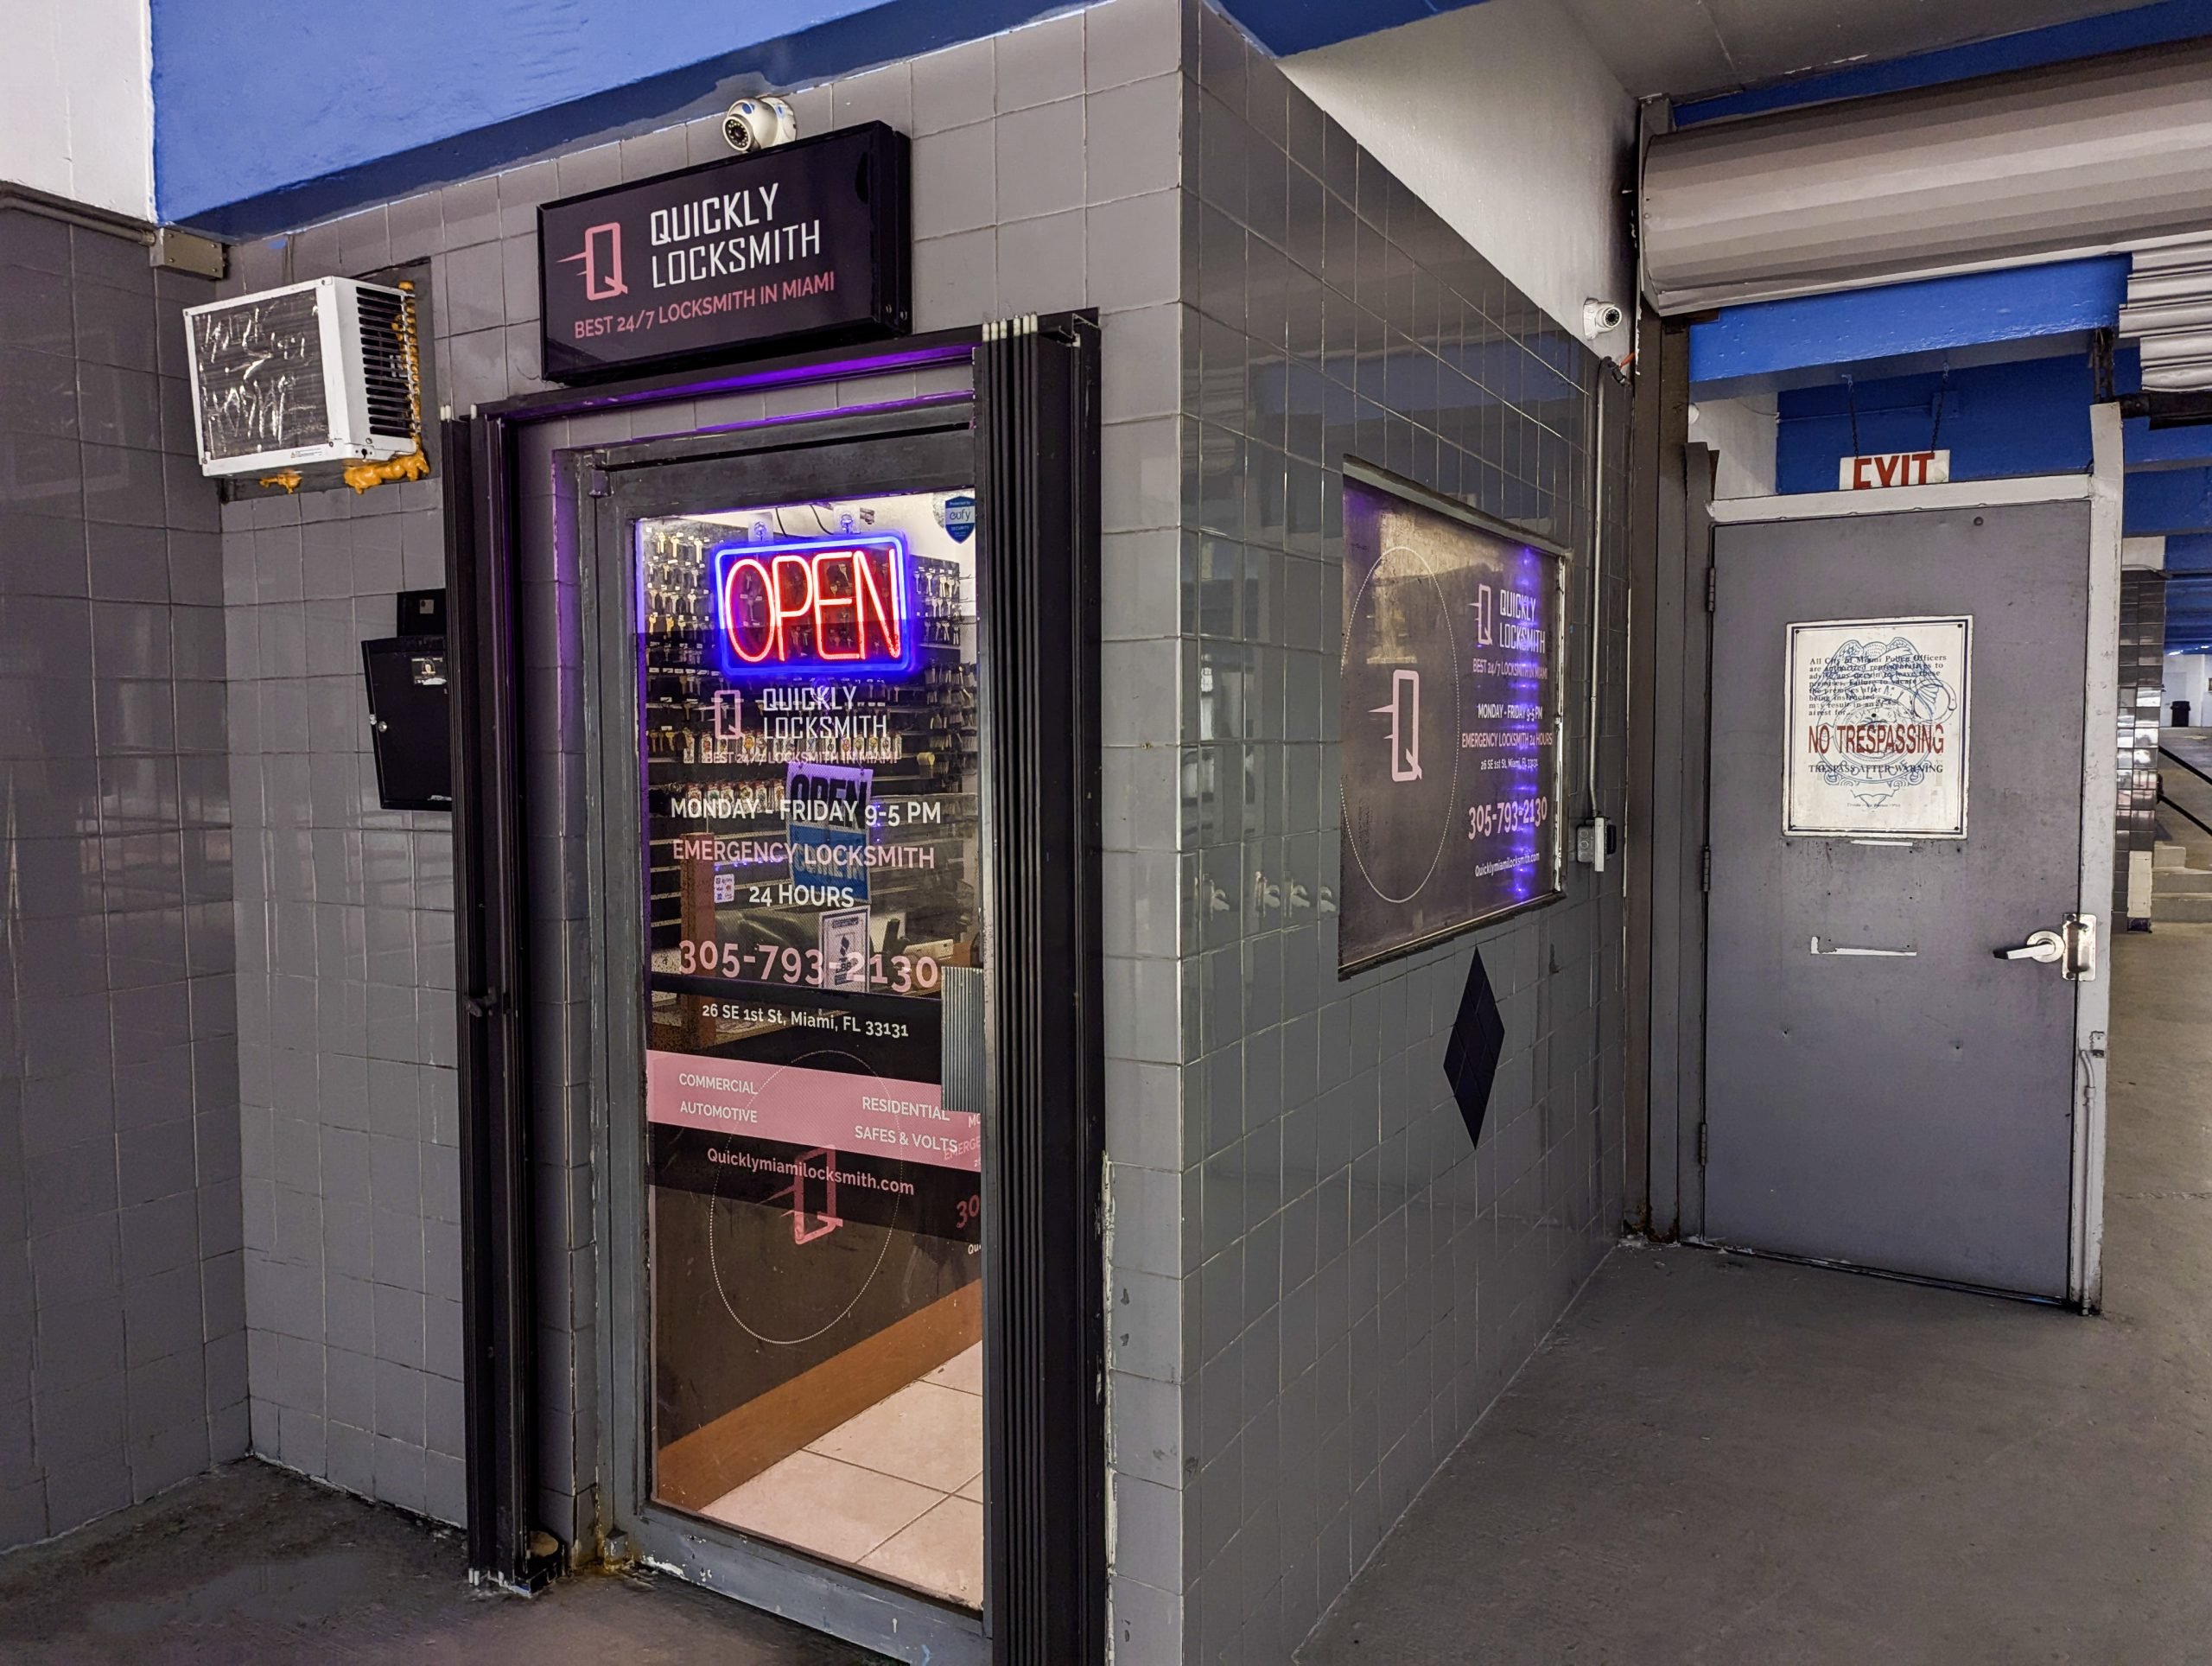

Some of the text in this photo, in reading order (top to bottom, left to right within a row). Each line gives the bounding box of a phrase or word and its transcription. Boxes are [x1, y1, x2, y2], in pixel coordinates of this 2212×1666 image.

[650, 182, 779, 246] QUICKLY
[652, 219, 820, 289] LOCKSMITH
[575, 270, 835, 340] BEST 24/7 LOCKSMITH IN MIAMI
[949, 508, 970, 521] eufy
[724, 548, 902, 663] OPEN
[1499, 589, 1536, 622] QUICKLY
[1499, 622, 1546, 654] LOCKSMITH
[1472, 658, 1487, 673] BEST
[1488, 660, 1501, 677] 24/7
[762, 685, 857, 713] QUICKLY
[1478, 703, 1503, 718] MONDAY
[1507, 704, 1526, 719] FRIDAY
[1526, 708, 1535, 722] 9-5
[1535, 705, 1543, 719] PM
[763, 715, 887, 741] LOCKSMITH
[1462, 732, 1553, 748] EMERGENCY LOCKSMITH 24 HOURS
[1808, 723, 1944, 754] NO TRESPASSING
[706, 752, 734, 766] BEST
[736, 753, 765, 767] 24/7
[767, 751, 839, 765] LOCKSMITH
[859, 751, 898, 766] MIAMI
[1487, 759, 1494, 770] SE
[1808, 764, 1943, 773] TRESPASS AFTER WARNING
[671, 798, 760, 820] MONDAY
[780, 800, 859, 822] FRIDAY
[866, 804, 901, 827] 9-5
[907, 802, 941, 823] PM
[1468, 796, 1548, 840] 305-793-2130
[672, 839, 934, 869] EMERGENCY LOCKSMITH
[748, 886, 772, 907] 24
[779, 884, 855, 908] HOURS
[678, 939, 939, 994] 305-793-2130
[702, 1003, 909, 1039] 26 SE 1st St, Miami, FL 33131
[678, 1072, 759, 1096] COMMERCIAL
[680, 1101, 758, 1123] AUTOMOTIVE
[862, 1097, 950, 1122] RESIDENTIAL
[855, 1125, 958, 1154] SAFES & VOLTS
[707, 1148, 915, 1196] Quicklymiamilocksmith.com
